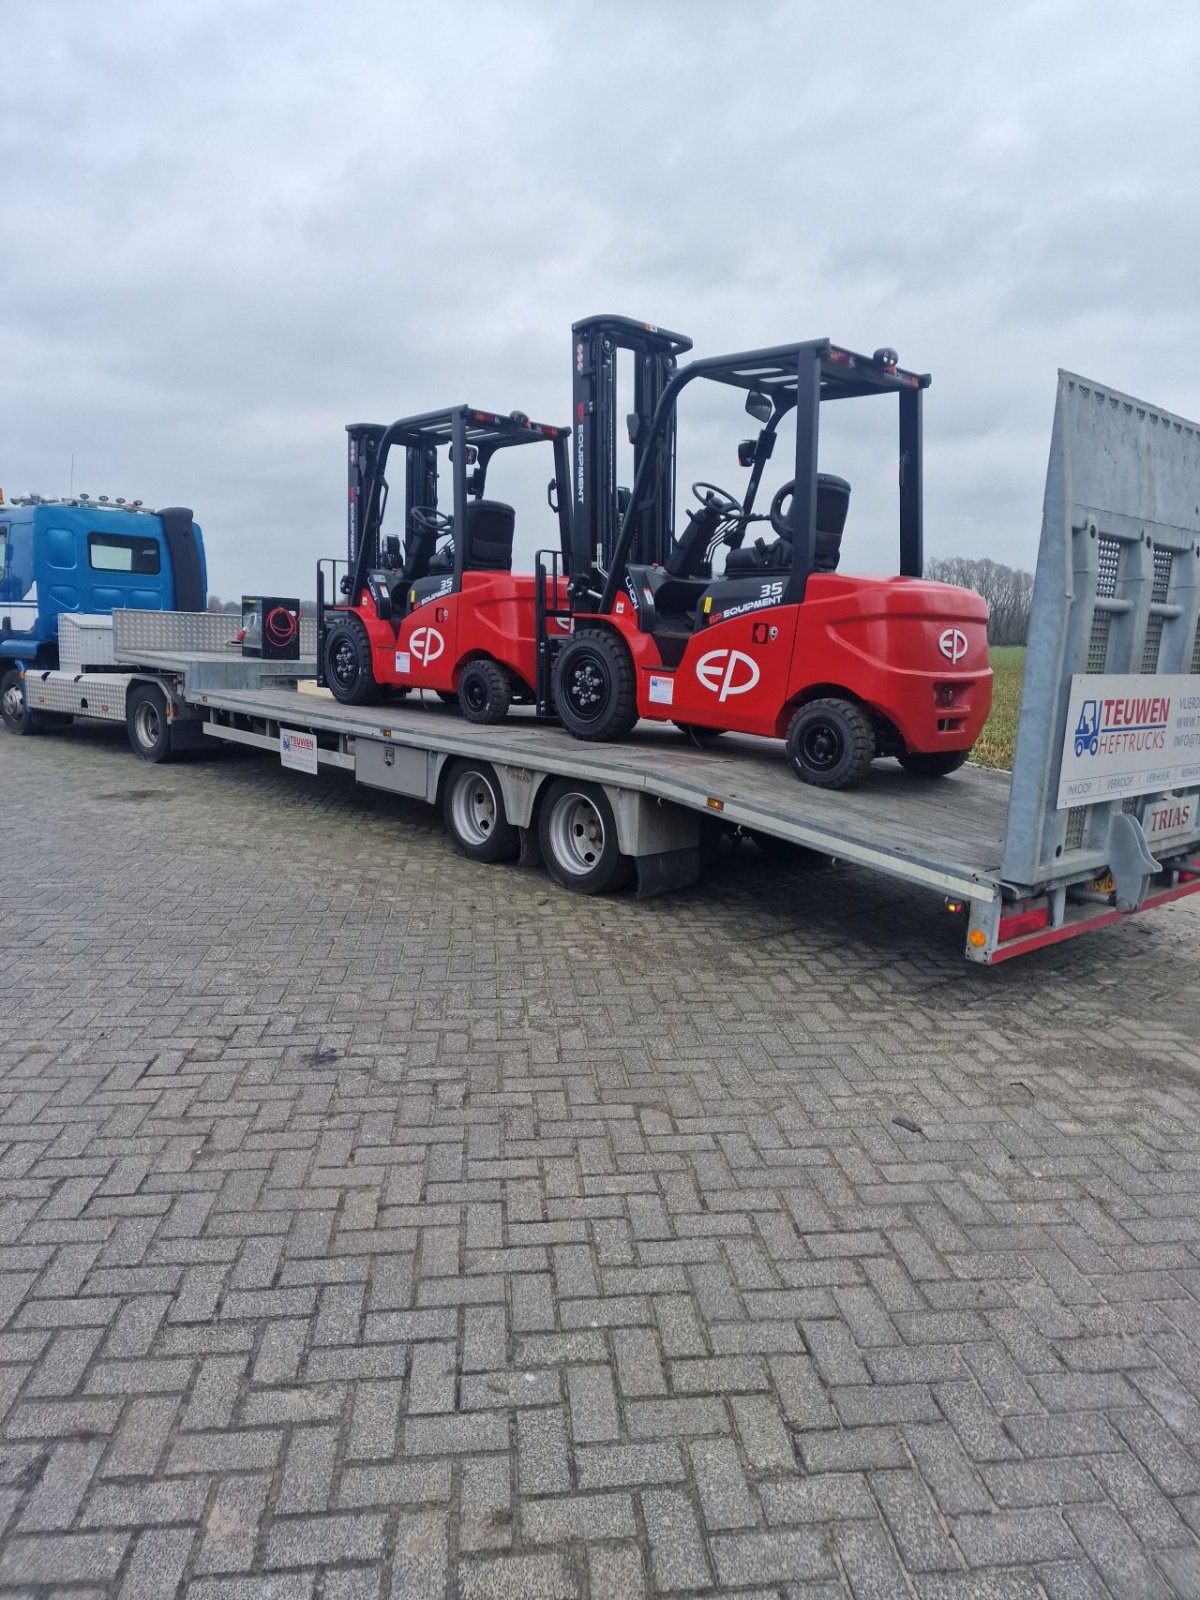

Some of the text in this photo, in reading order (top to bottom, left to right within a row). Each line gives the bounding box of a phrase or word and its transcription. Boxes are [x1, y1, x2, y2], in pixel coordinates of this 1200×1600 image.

[440, 577, 453, 590] 35
[760, 581, 783, 598] 35
[723, 595, 783, 618] EQUIPMENT
[409, 627, 445, 667] EP
[939, 628, 968, 665] EP
[696, 649, 760, 702] EP
[1104, 697, 1170, 726] TEUWEN
[289, 735, 314, 749] TEUWEN
[1099, 730, 1167, 755] HEFTRUCKS
[1067, 782, 1093, 796] INKOOP
[1106, 776, 1135, 790] VERKOOP
[1151, 805, 1191, 832] TRIAS
